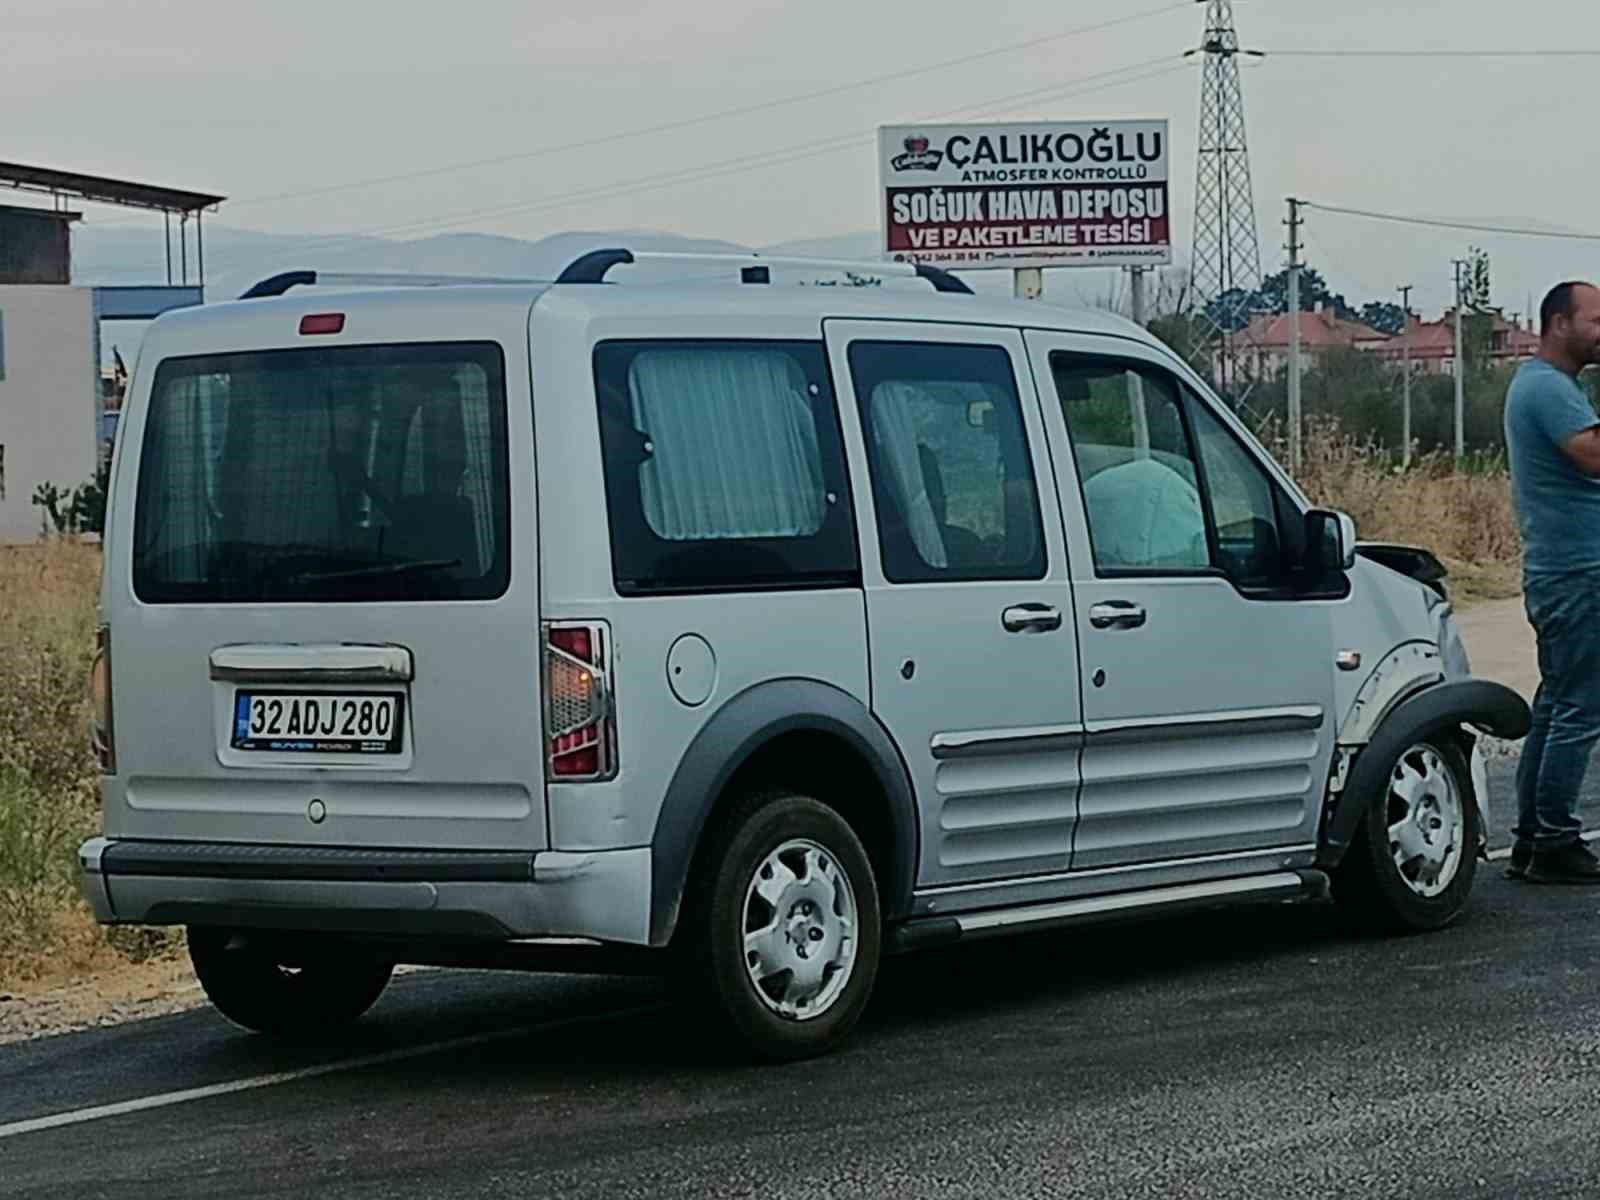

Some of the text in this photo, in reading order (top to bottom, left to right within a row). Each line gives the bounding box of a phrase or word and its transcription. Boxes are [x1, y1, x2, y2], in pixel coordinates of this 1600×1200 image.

[946, 127, 1161, 169] ÇALIKOĞLU
[961, 164, 1147, 183] ATMOSFER KONTROLLÜ
[893, 187, 1164, 223] SOĞUK HAVA DEPOSU
[909, 218, 1150, 249] VE PAKETLEME TESİSİ
[251, 698, 390, 736] 32 ADJ 280
